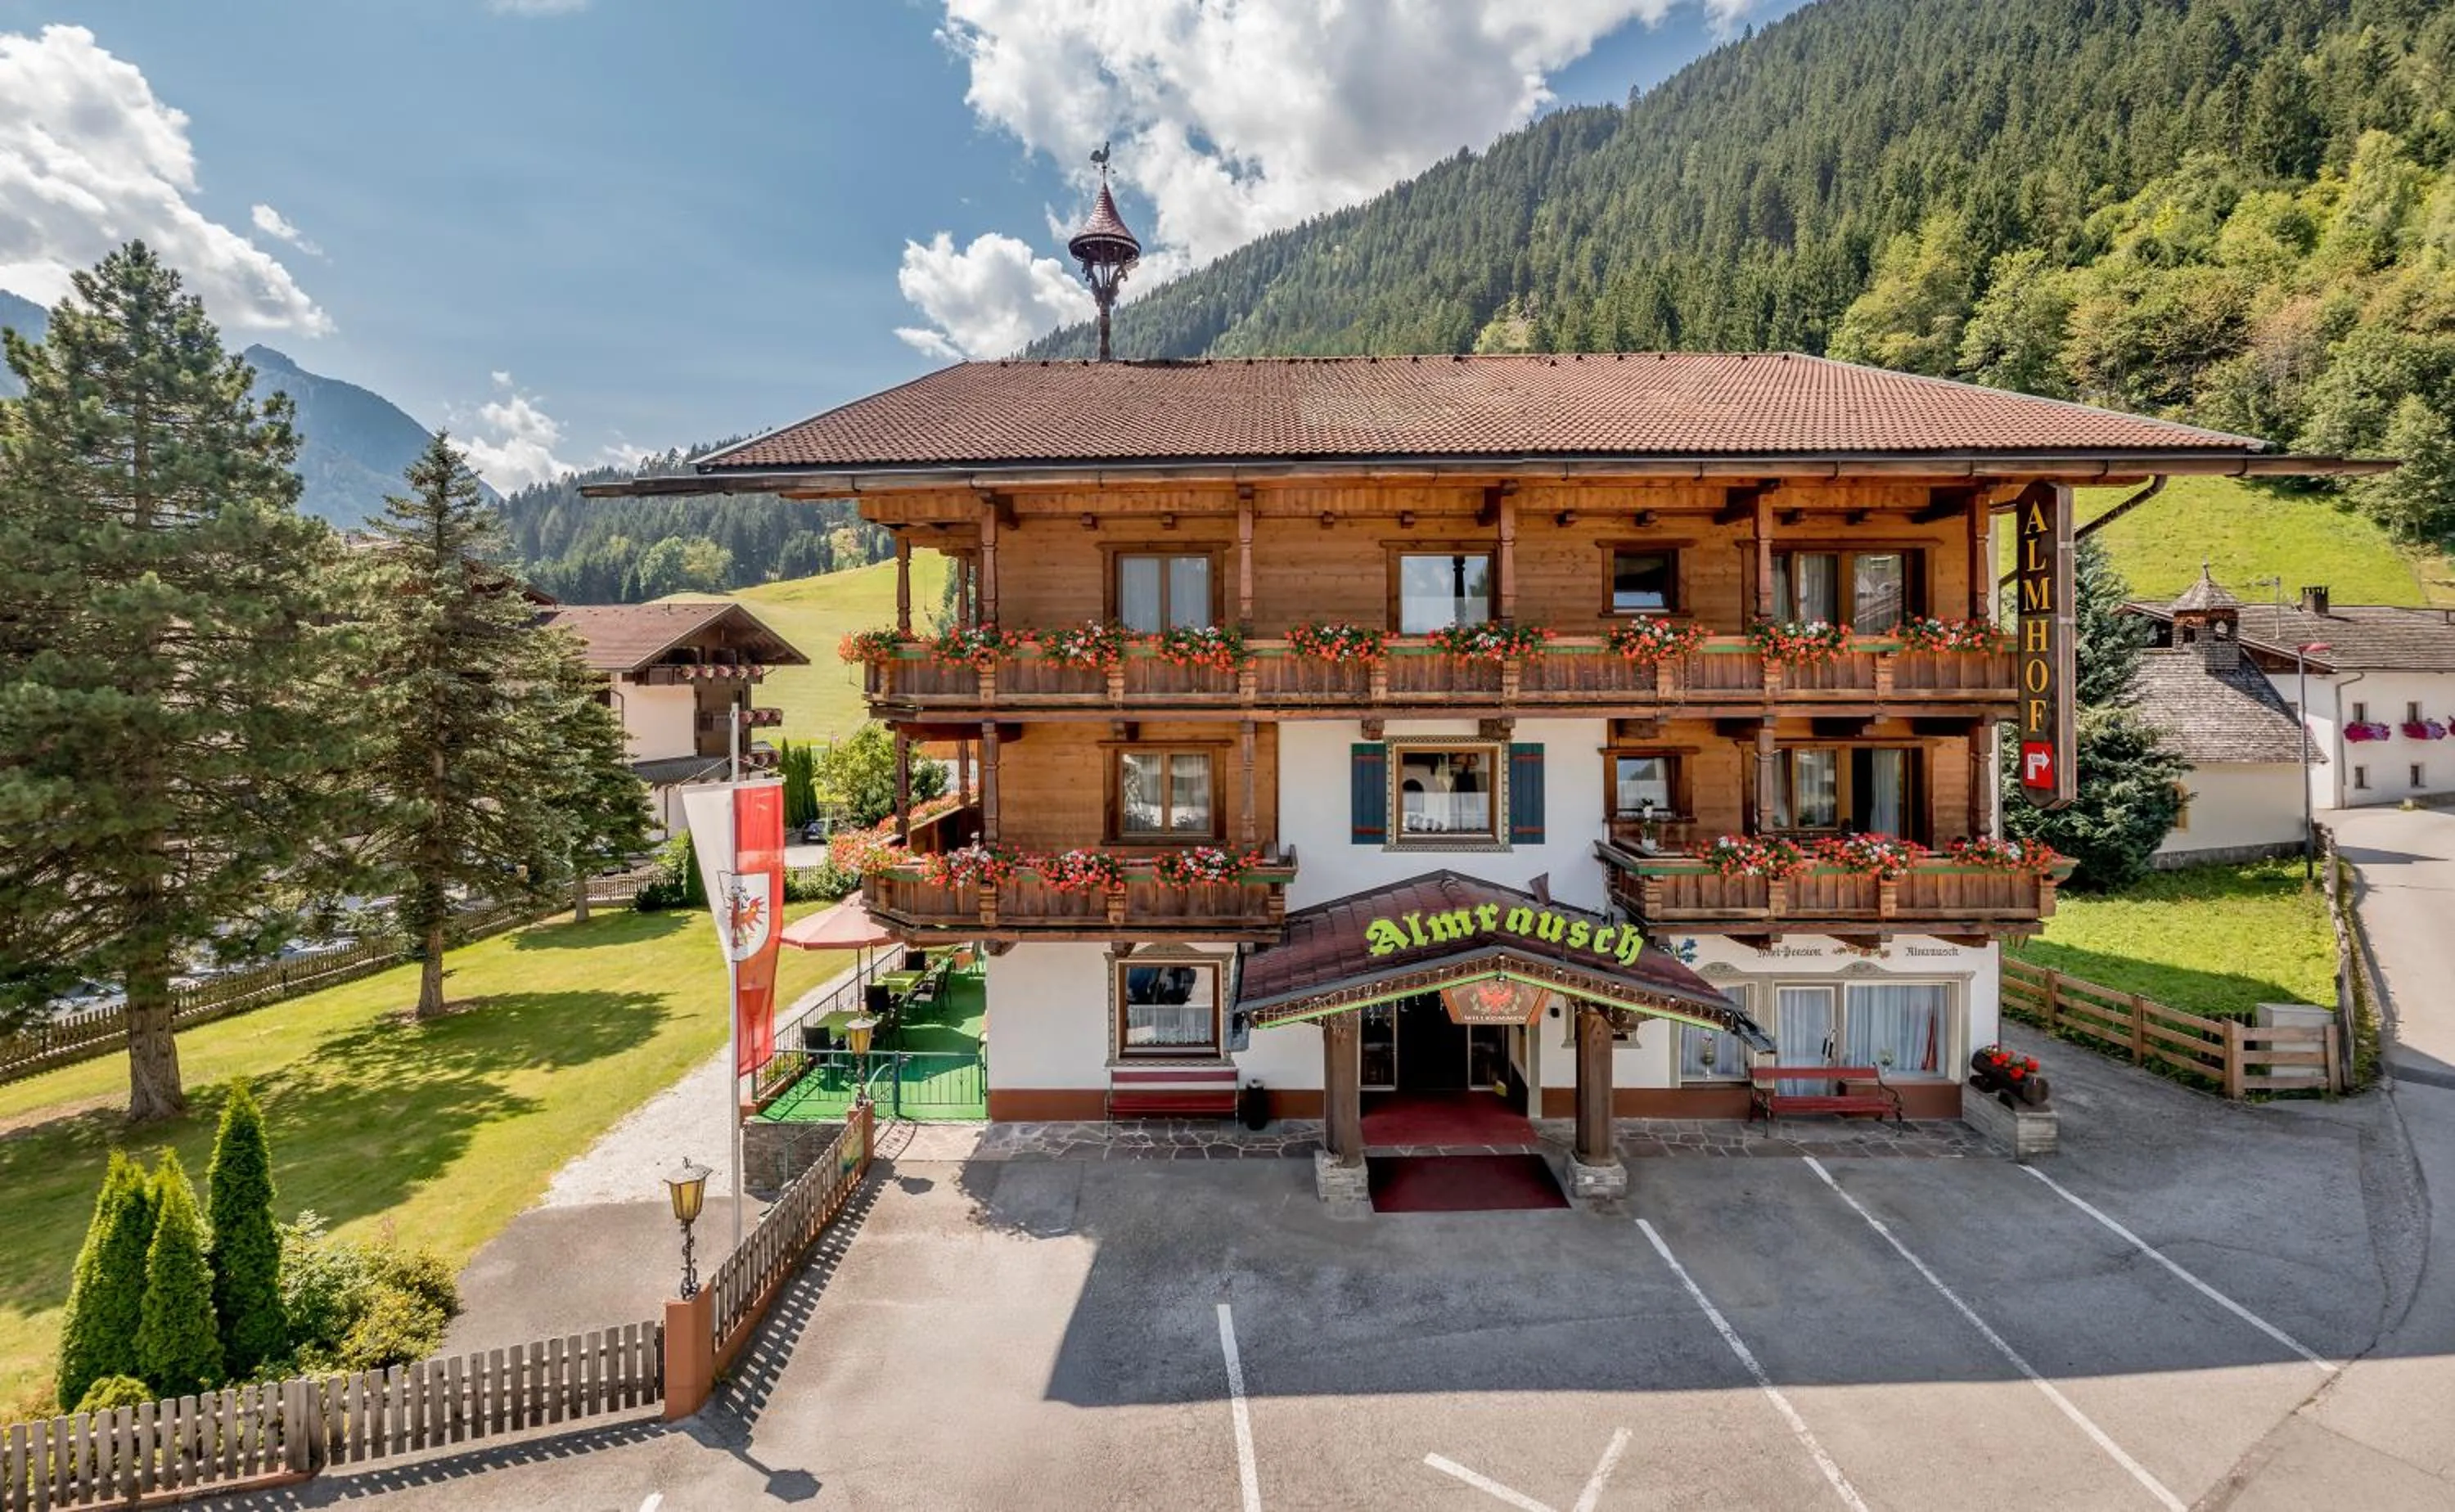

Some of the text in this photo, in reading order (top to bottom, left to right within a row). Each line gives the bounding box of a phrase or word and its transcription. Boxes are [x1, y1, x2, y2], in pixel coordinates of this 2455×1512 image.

[2024, 500, 2051, 733] ALMHOF
[1366, 902, 1644, 967] Almrausch
[1905, 946, 1960, 956] Almrausch
